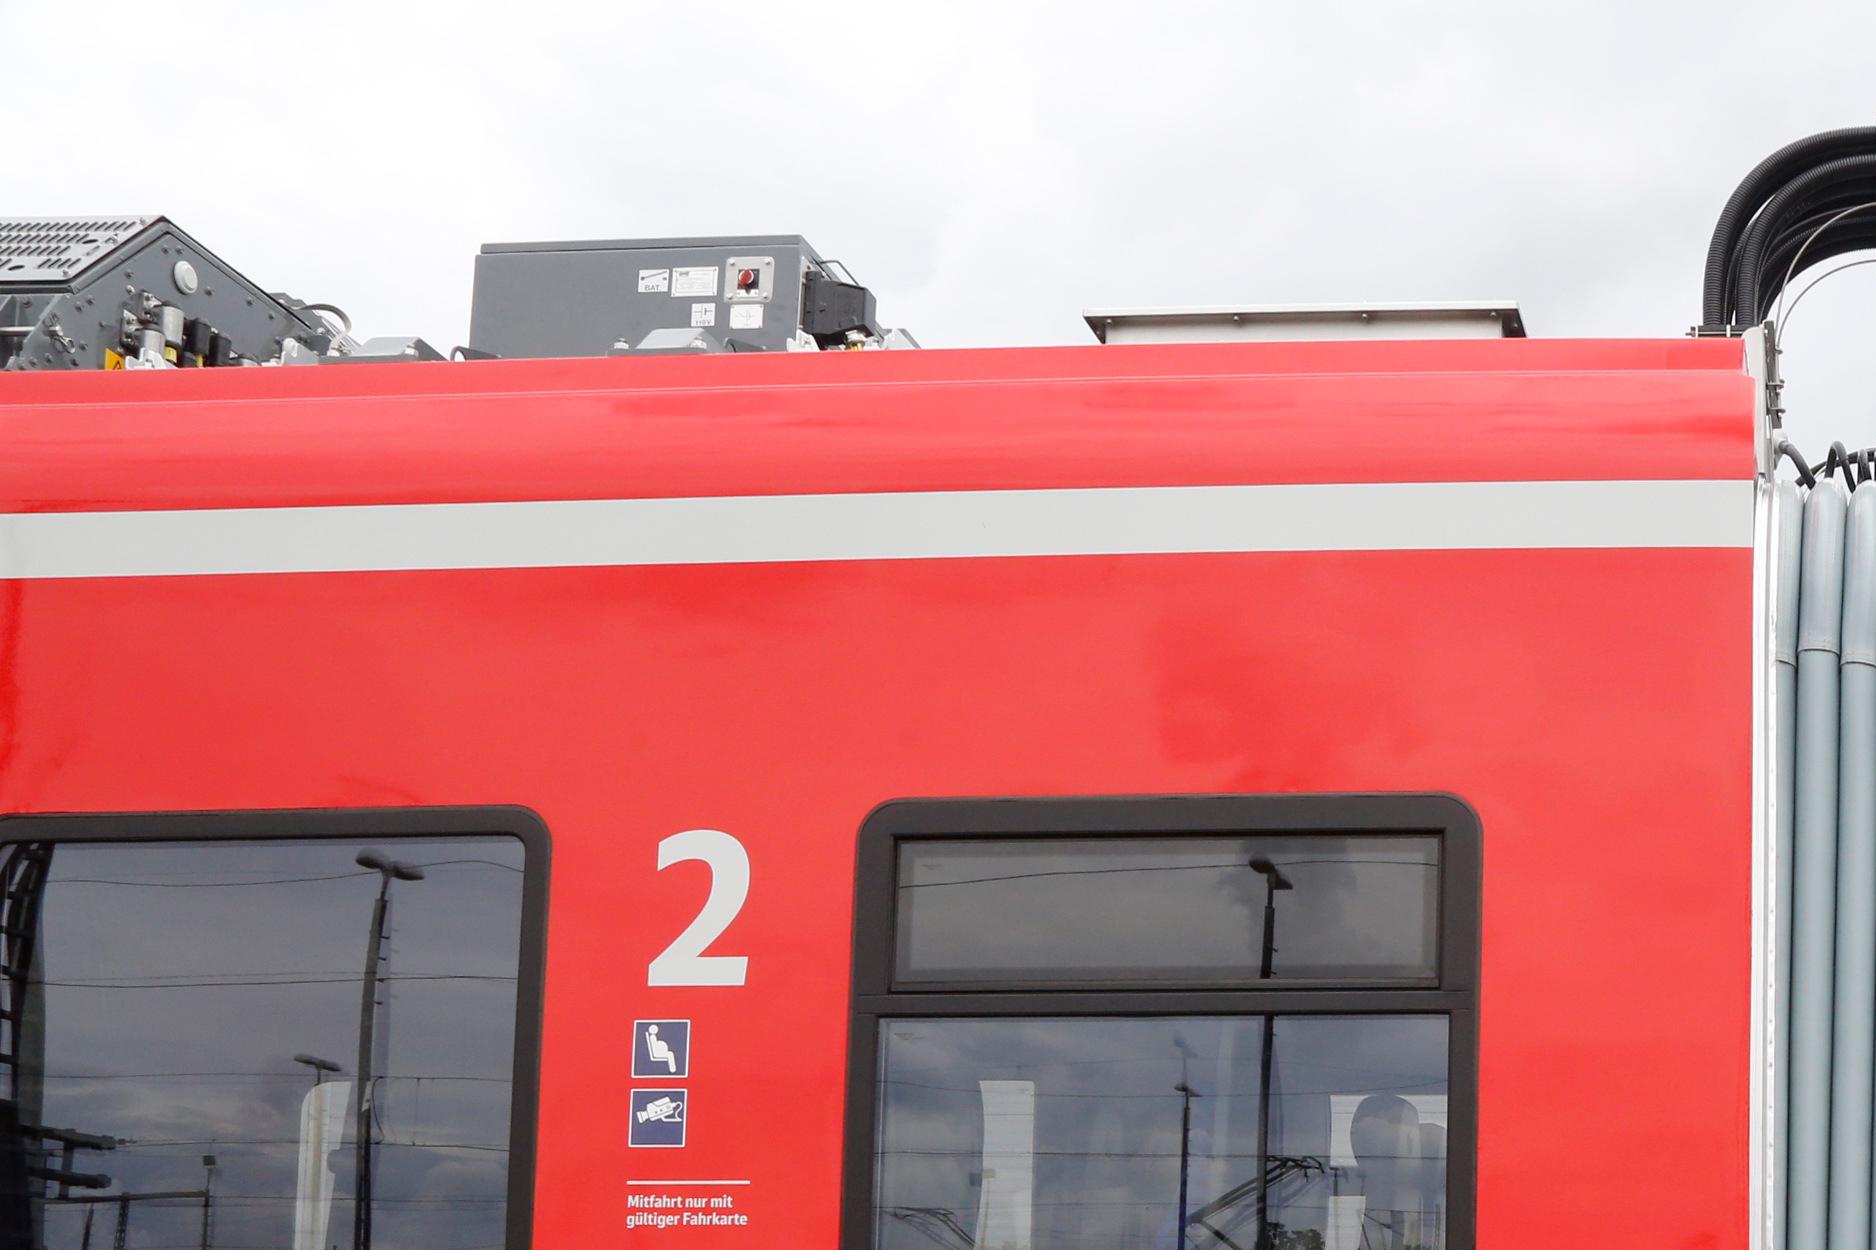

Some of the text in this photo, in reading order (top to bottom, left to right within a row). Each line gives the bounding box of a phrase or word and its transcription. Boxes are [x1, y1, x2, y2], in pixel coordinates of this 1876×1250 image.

[647, 829, 751, 987] 2
[627, 1194, 733, 1209] Mitfahrt nur mit
[626, 1212, 748, 1228] gültiger Fahrkarte
